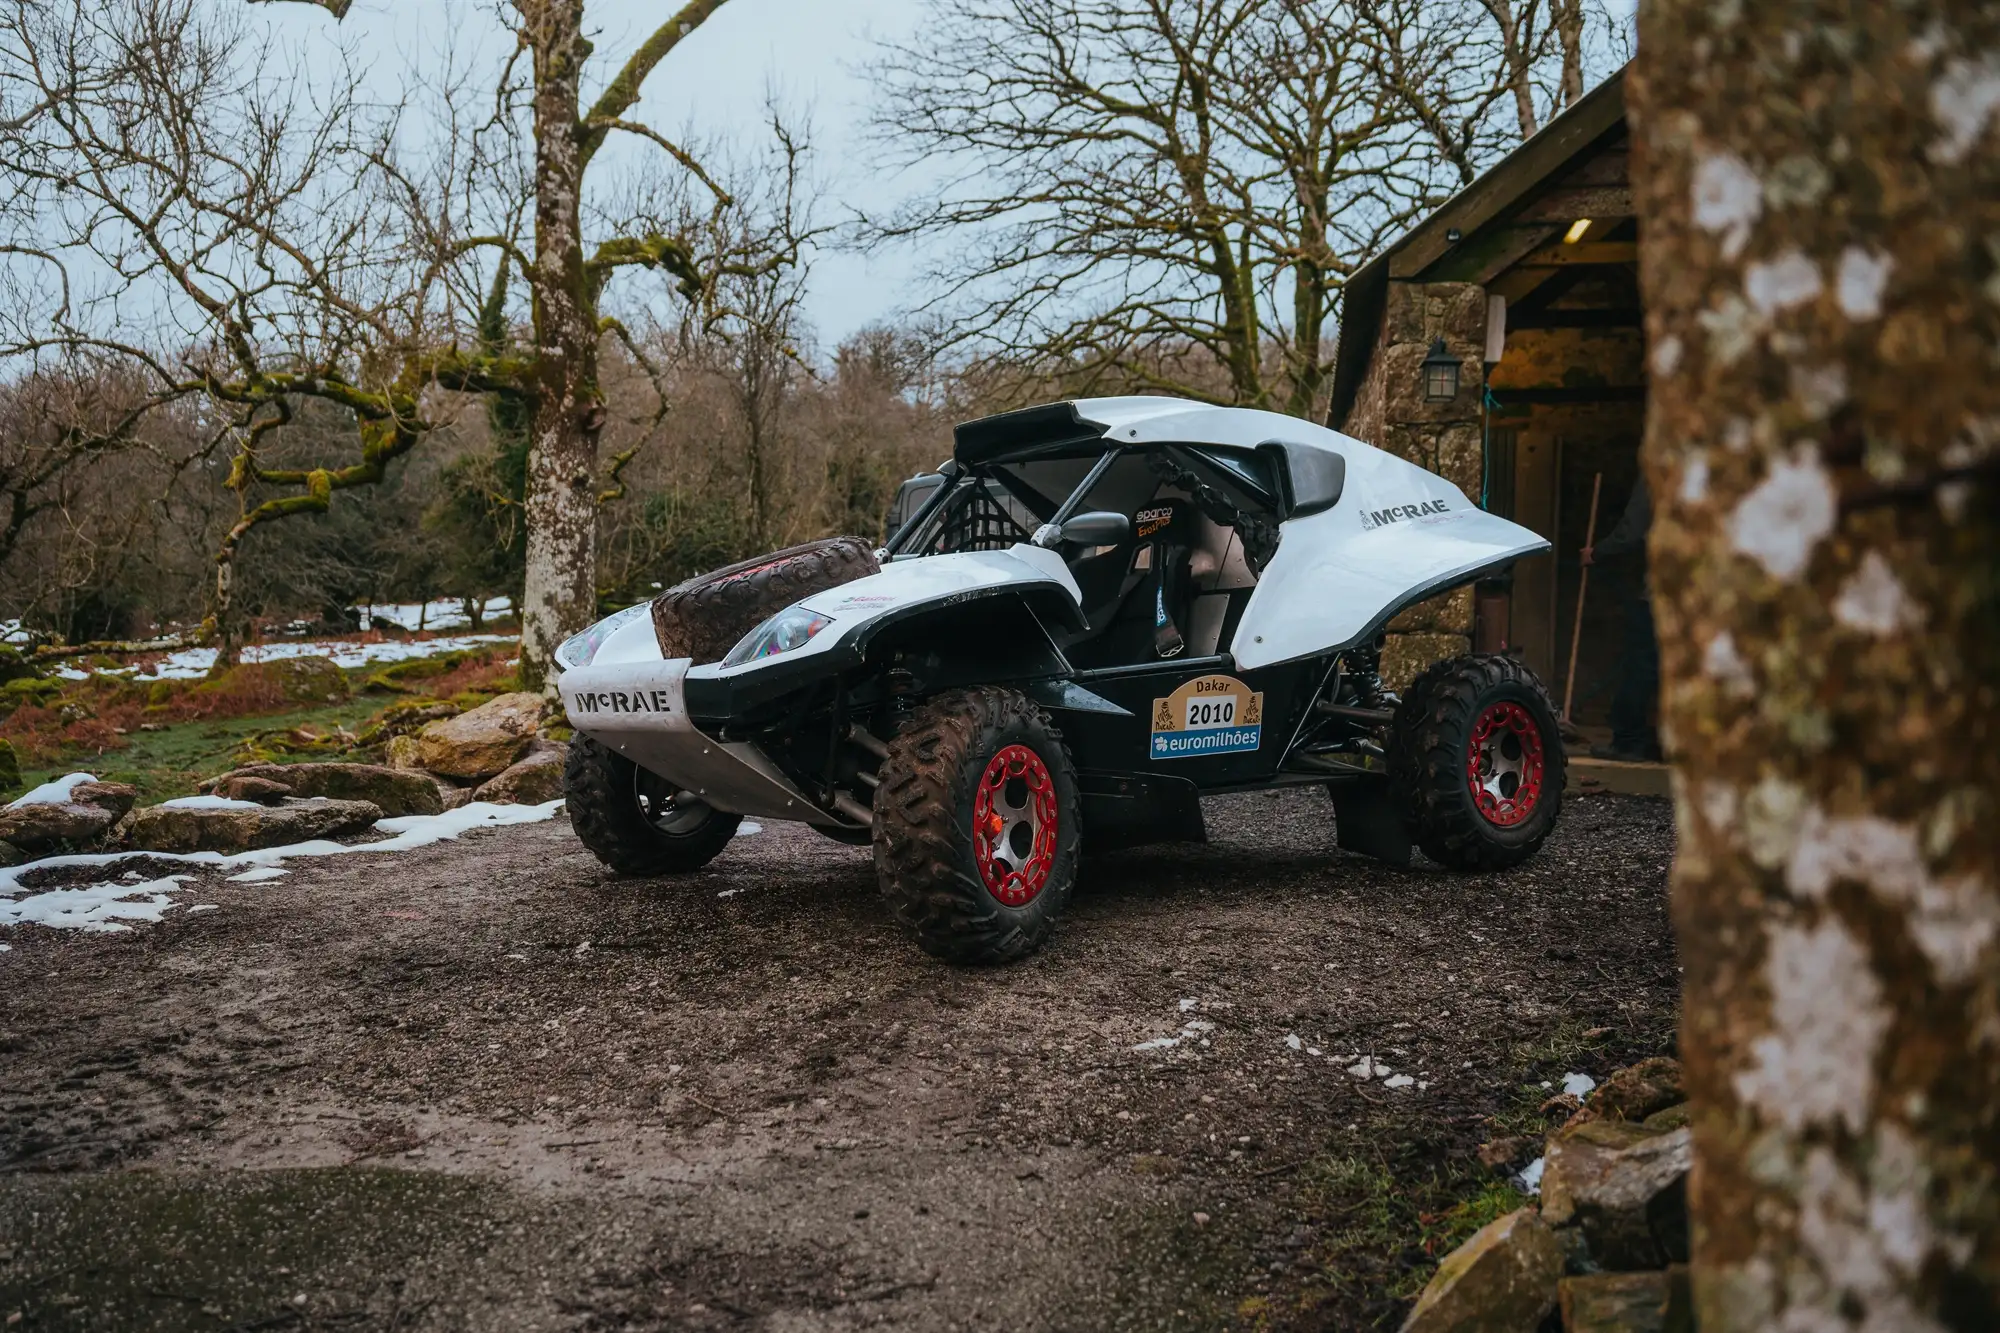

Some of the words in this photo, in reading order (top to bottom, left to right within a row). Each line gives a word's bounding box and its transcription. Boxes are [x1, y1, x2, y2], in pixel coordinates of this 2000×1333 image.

[1136, 507, 1173, 522] sparco
[1196, 679, 1231, 693] Dakar
[1189, 703, 1234, 725] 2010
